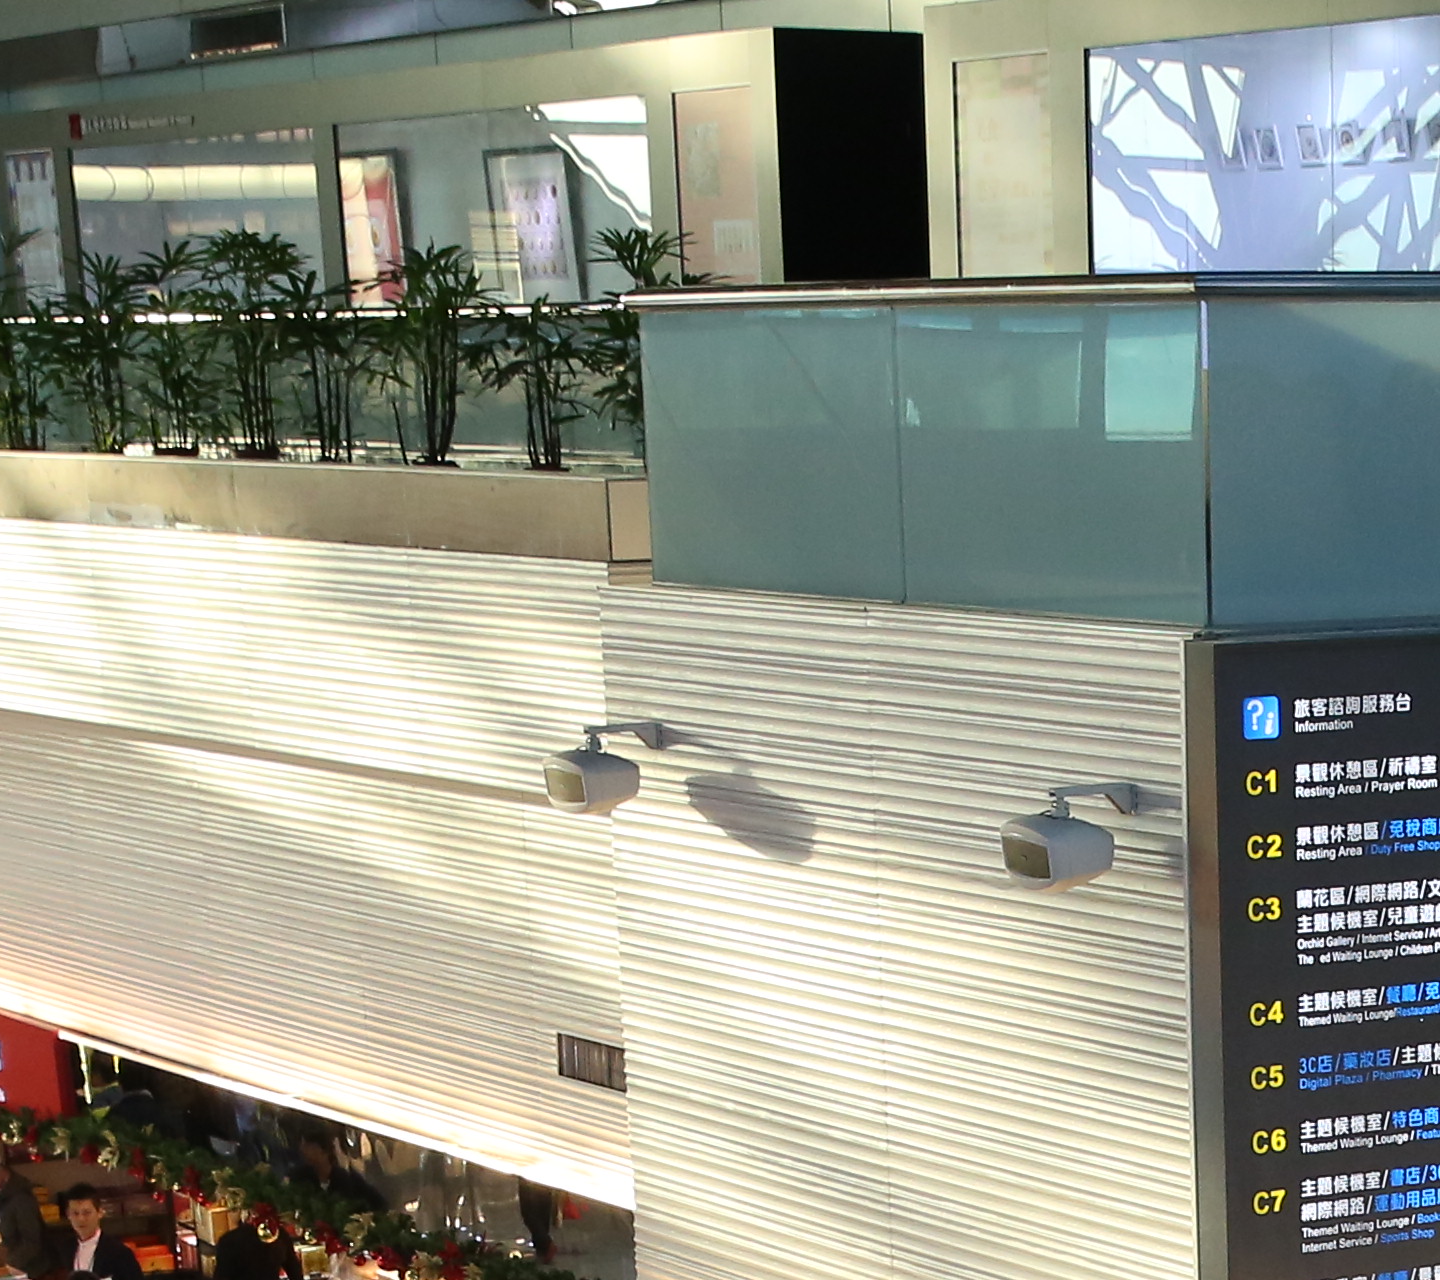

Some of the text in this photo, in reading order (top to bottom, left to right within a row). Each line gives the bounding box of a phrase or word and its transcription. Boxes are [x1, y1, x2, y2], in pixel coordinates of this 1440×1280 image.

[1294, 693, 1412, 719] 旅客諮詢服務台
[1294, 719, 1354, 734] Information
[1246, 769, 1278, 796] C1
[1295, 777, 1438, 799] Resting Area Prayer Room
[1247, 835, 1283, 859] C2
[1297, 847, 1336, 862] Resting
[1338, 844, 1363, 858] Area
[1394, 841, 1415, 853] Free
[1248, 897, 1281, 922] C3
[1297, 929, 1423, 951] Orchid Gallery Internet Service
[1364, 945, 1393, 961] Lounge
[1249, 1001, 1284, 1026] C4
[1299, 1014, 1331, 1027] Themed
[1250, 1065, 1284, 1090] C5
[1300, 1075, 1332, 1091] Digital
[1252, 1129, 1287, 1155] C6
[1301, 1133, 1408, 1154] Themed Waiting Lounge
[1253, 1190, 1287, 1214] C7
[1301, 1217, 1409, 1239] Themed Lounge
[1302, 1236, 1373, 1254] Internet Service
